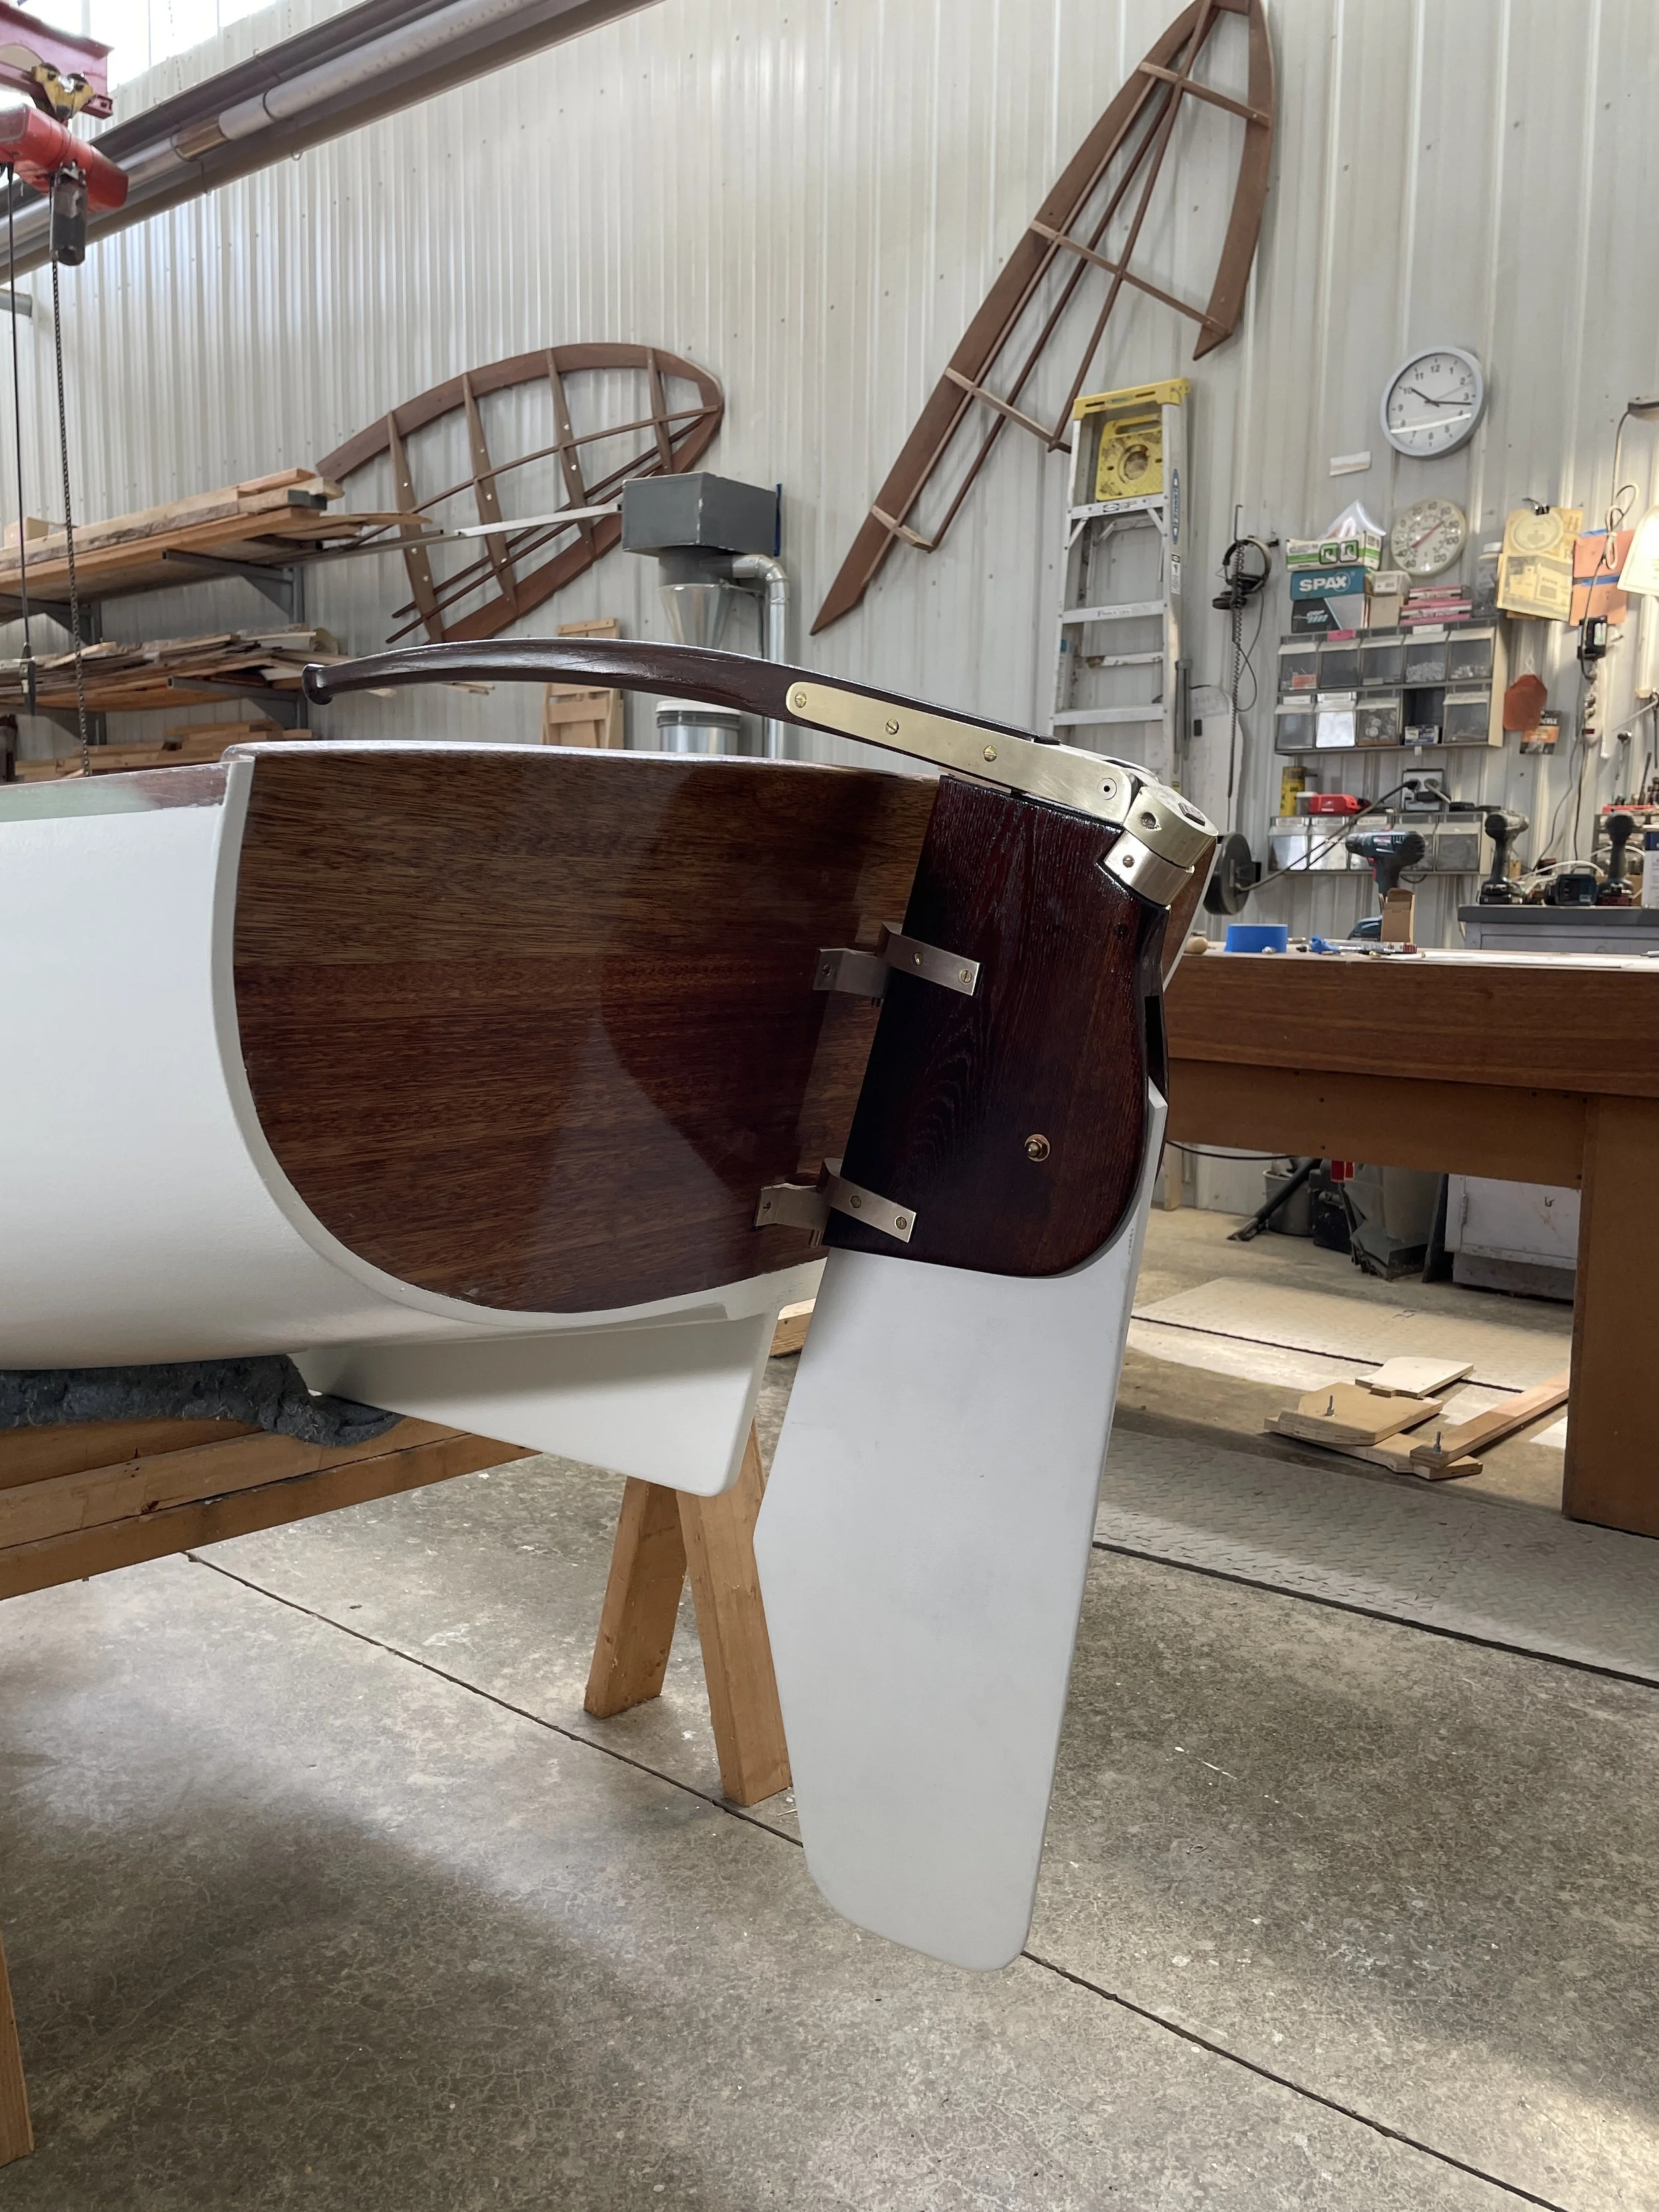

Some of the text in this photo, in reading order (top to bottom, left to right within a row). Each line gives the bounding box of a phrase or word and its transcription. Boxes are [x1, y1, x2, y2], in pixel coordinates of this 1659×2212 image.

[1431, 364, 1441, 373] 12
[1460, 377, 1466, 386] 2
[1464, 392, 1470, 401] 3
[1299, 575, 1347, 592] SPAX
